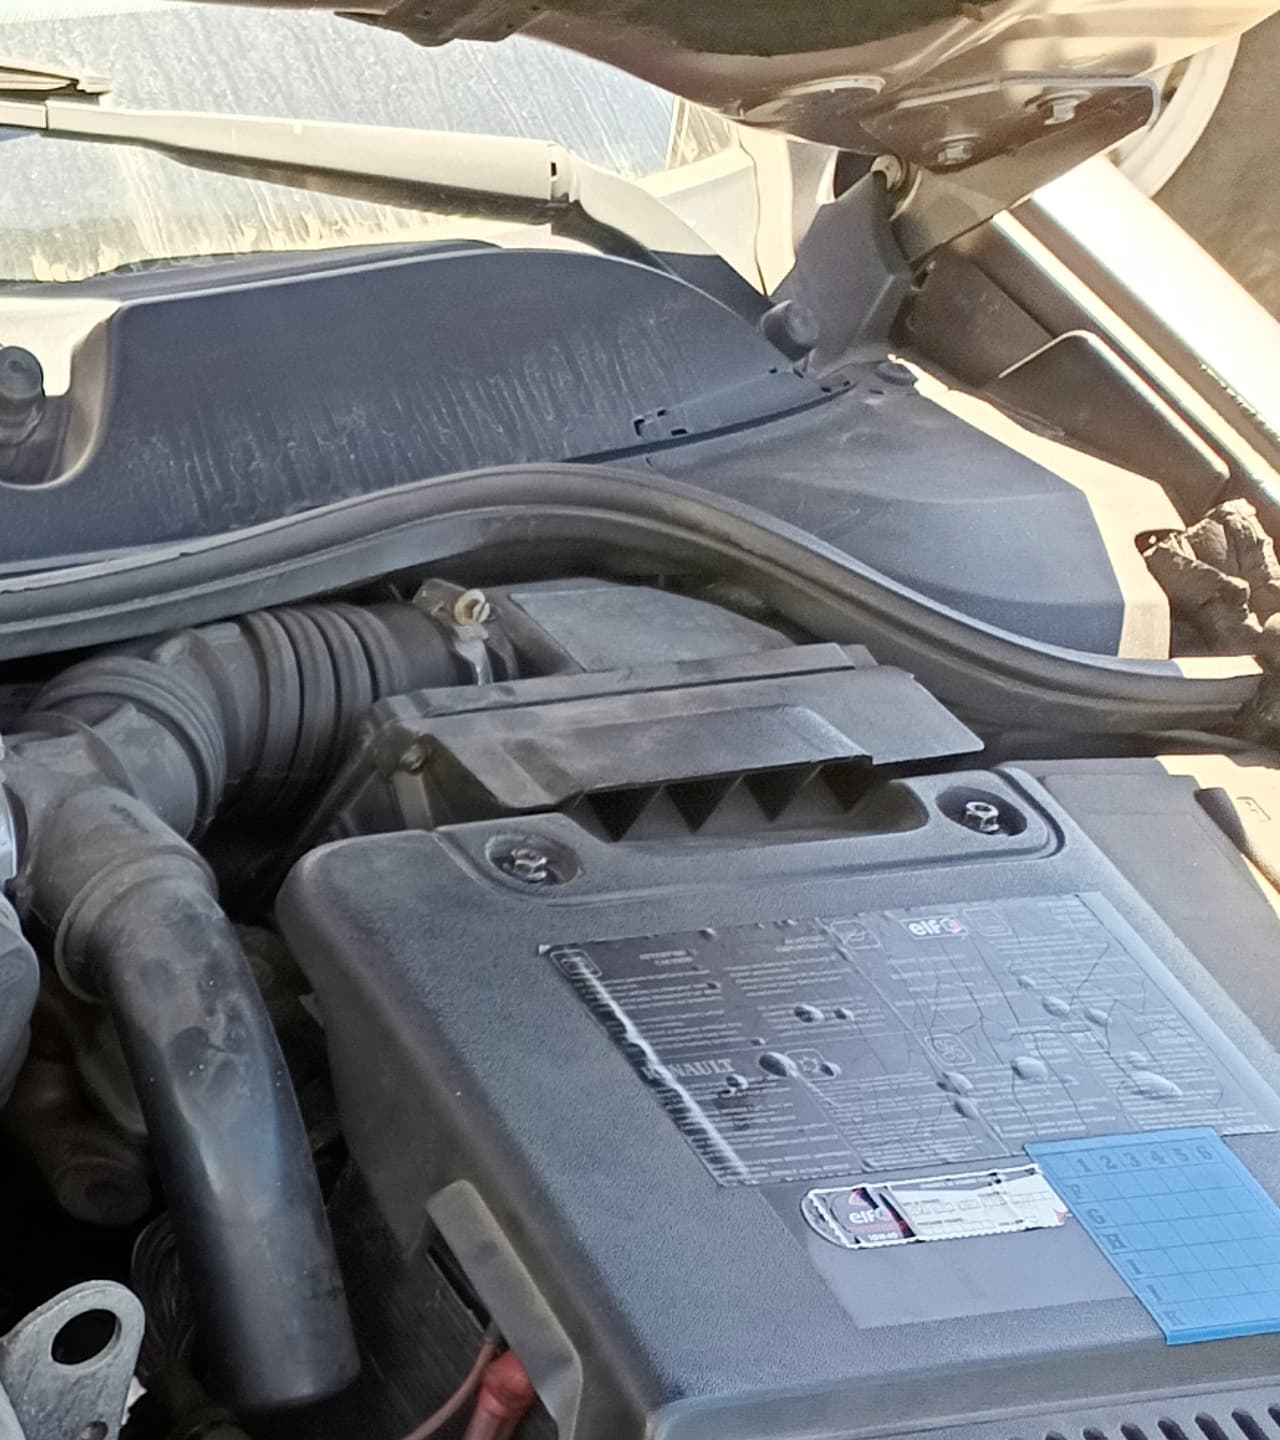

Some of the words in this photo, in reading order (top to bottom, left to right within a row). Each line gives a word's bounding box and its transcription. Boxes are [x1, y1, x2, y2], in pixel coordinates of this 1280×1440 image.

[908, 914, 942, 937] elf
[641, 1057, 736, 1080] RNAULT
[1076, 1157, 1092, 1173] 1
[1099, 1154, 1118, 1170] 2
[1123, 1151, 1141, 1168] 3
[1149, 1149, 1168, 1165] 4
[1172, 1147, 1191, 1163] 5
[1196, 1144, 1214, 1161] 6
